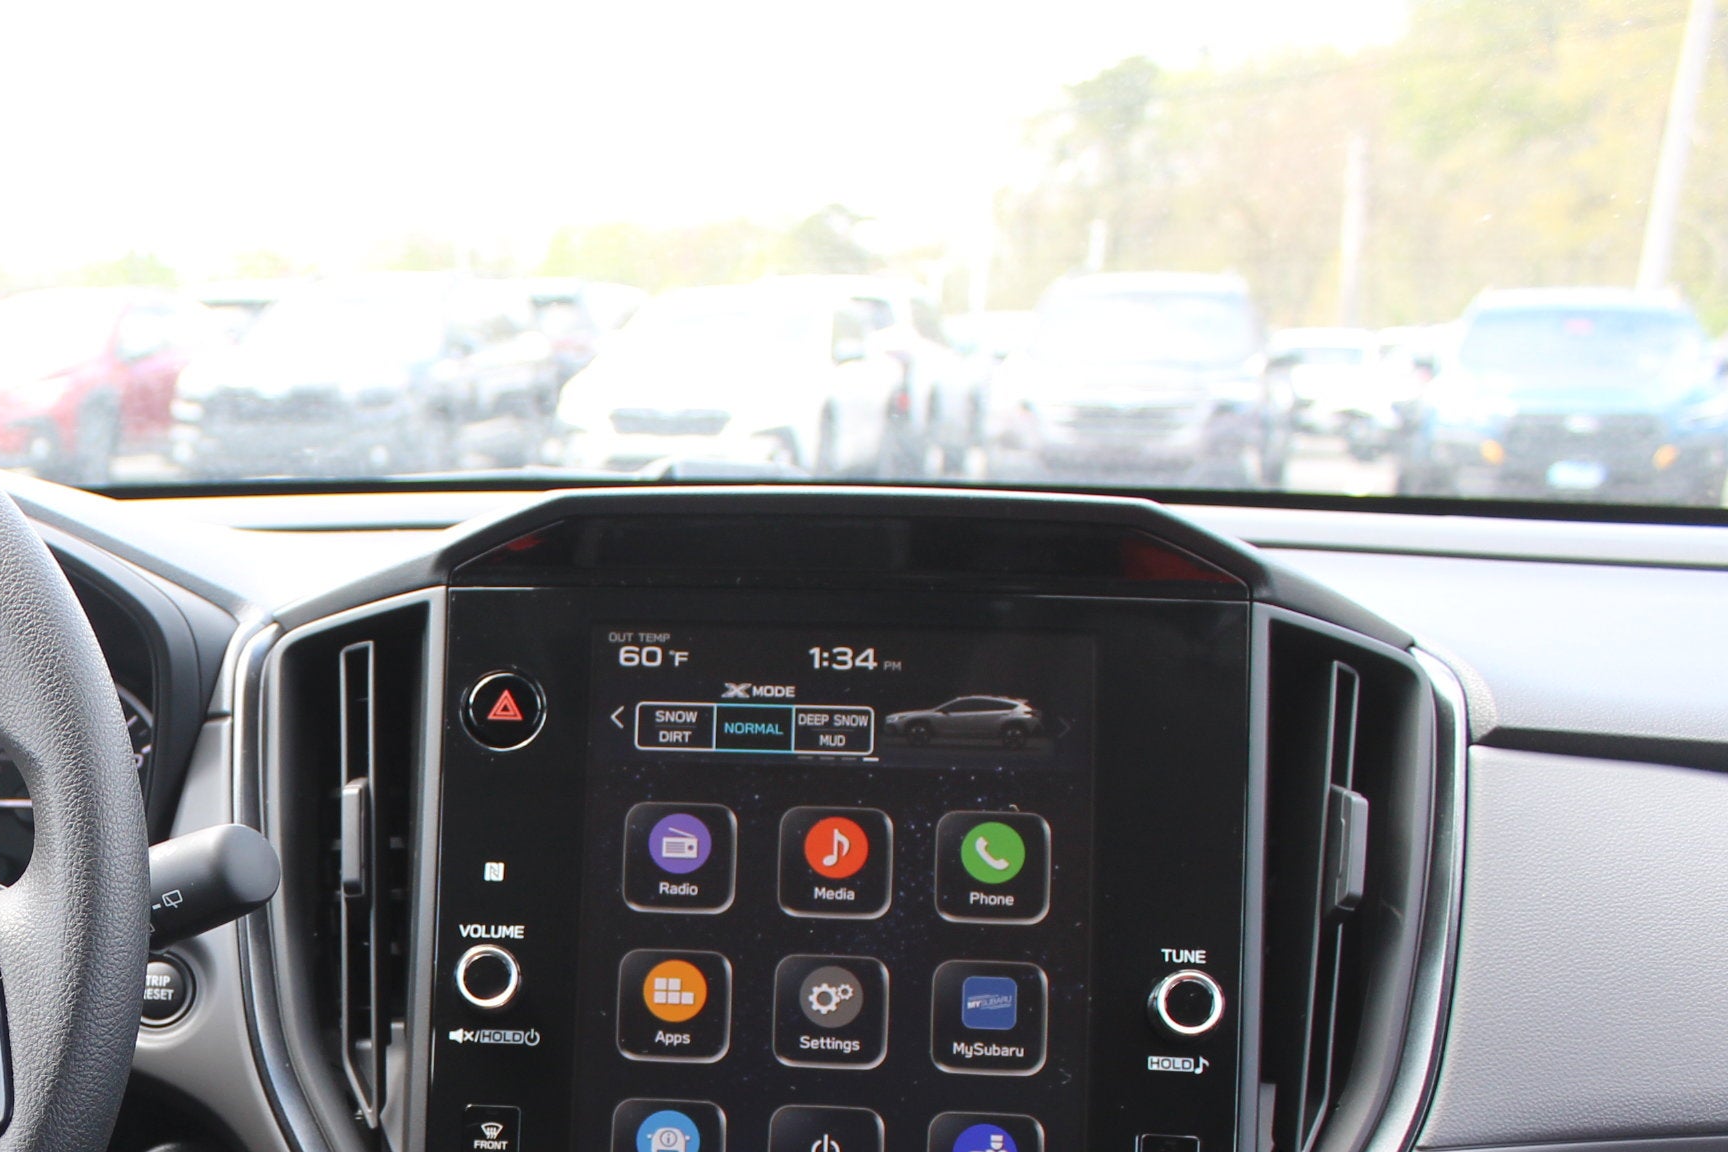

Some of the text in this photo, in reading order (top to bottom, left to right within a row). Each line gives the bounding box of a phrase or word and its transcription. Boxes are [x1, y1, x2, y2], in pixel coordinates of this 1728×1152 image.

[608, 631, 671, 643] OUT TEMP
[619, 645, 663, 667] 60
[809, 646, 902, 671] 1:34 PM
[655, 710, 698, 723] SNOW
[798, 713, 869, 727] DEEP SNOW
[724, 722, 784, 735] NORMAL
[659, 730, 692, 743] DIRT
[819, 735, 846, 747] MUD
[659, 881, 698, 896] Radio
[814, 887, 855, 901] Media
[970, 892, 1015, 907] Phone
[459, 924, 525, 939] VOLUME
[1161, 948, 1206, 964] TUNE
[145, 974, 171, 987] TRIP
[655, 1031, 691, 1047] Apps
[799, 1036, 860, 1053] Settings
[953, 1042, 1025, 1059] MySubaru
[1148, 1057, 1194, 1071] HOLD
[473, 1140, 508, 1151] FRONT
